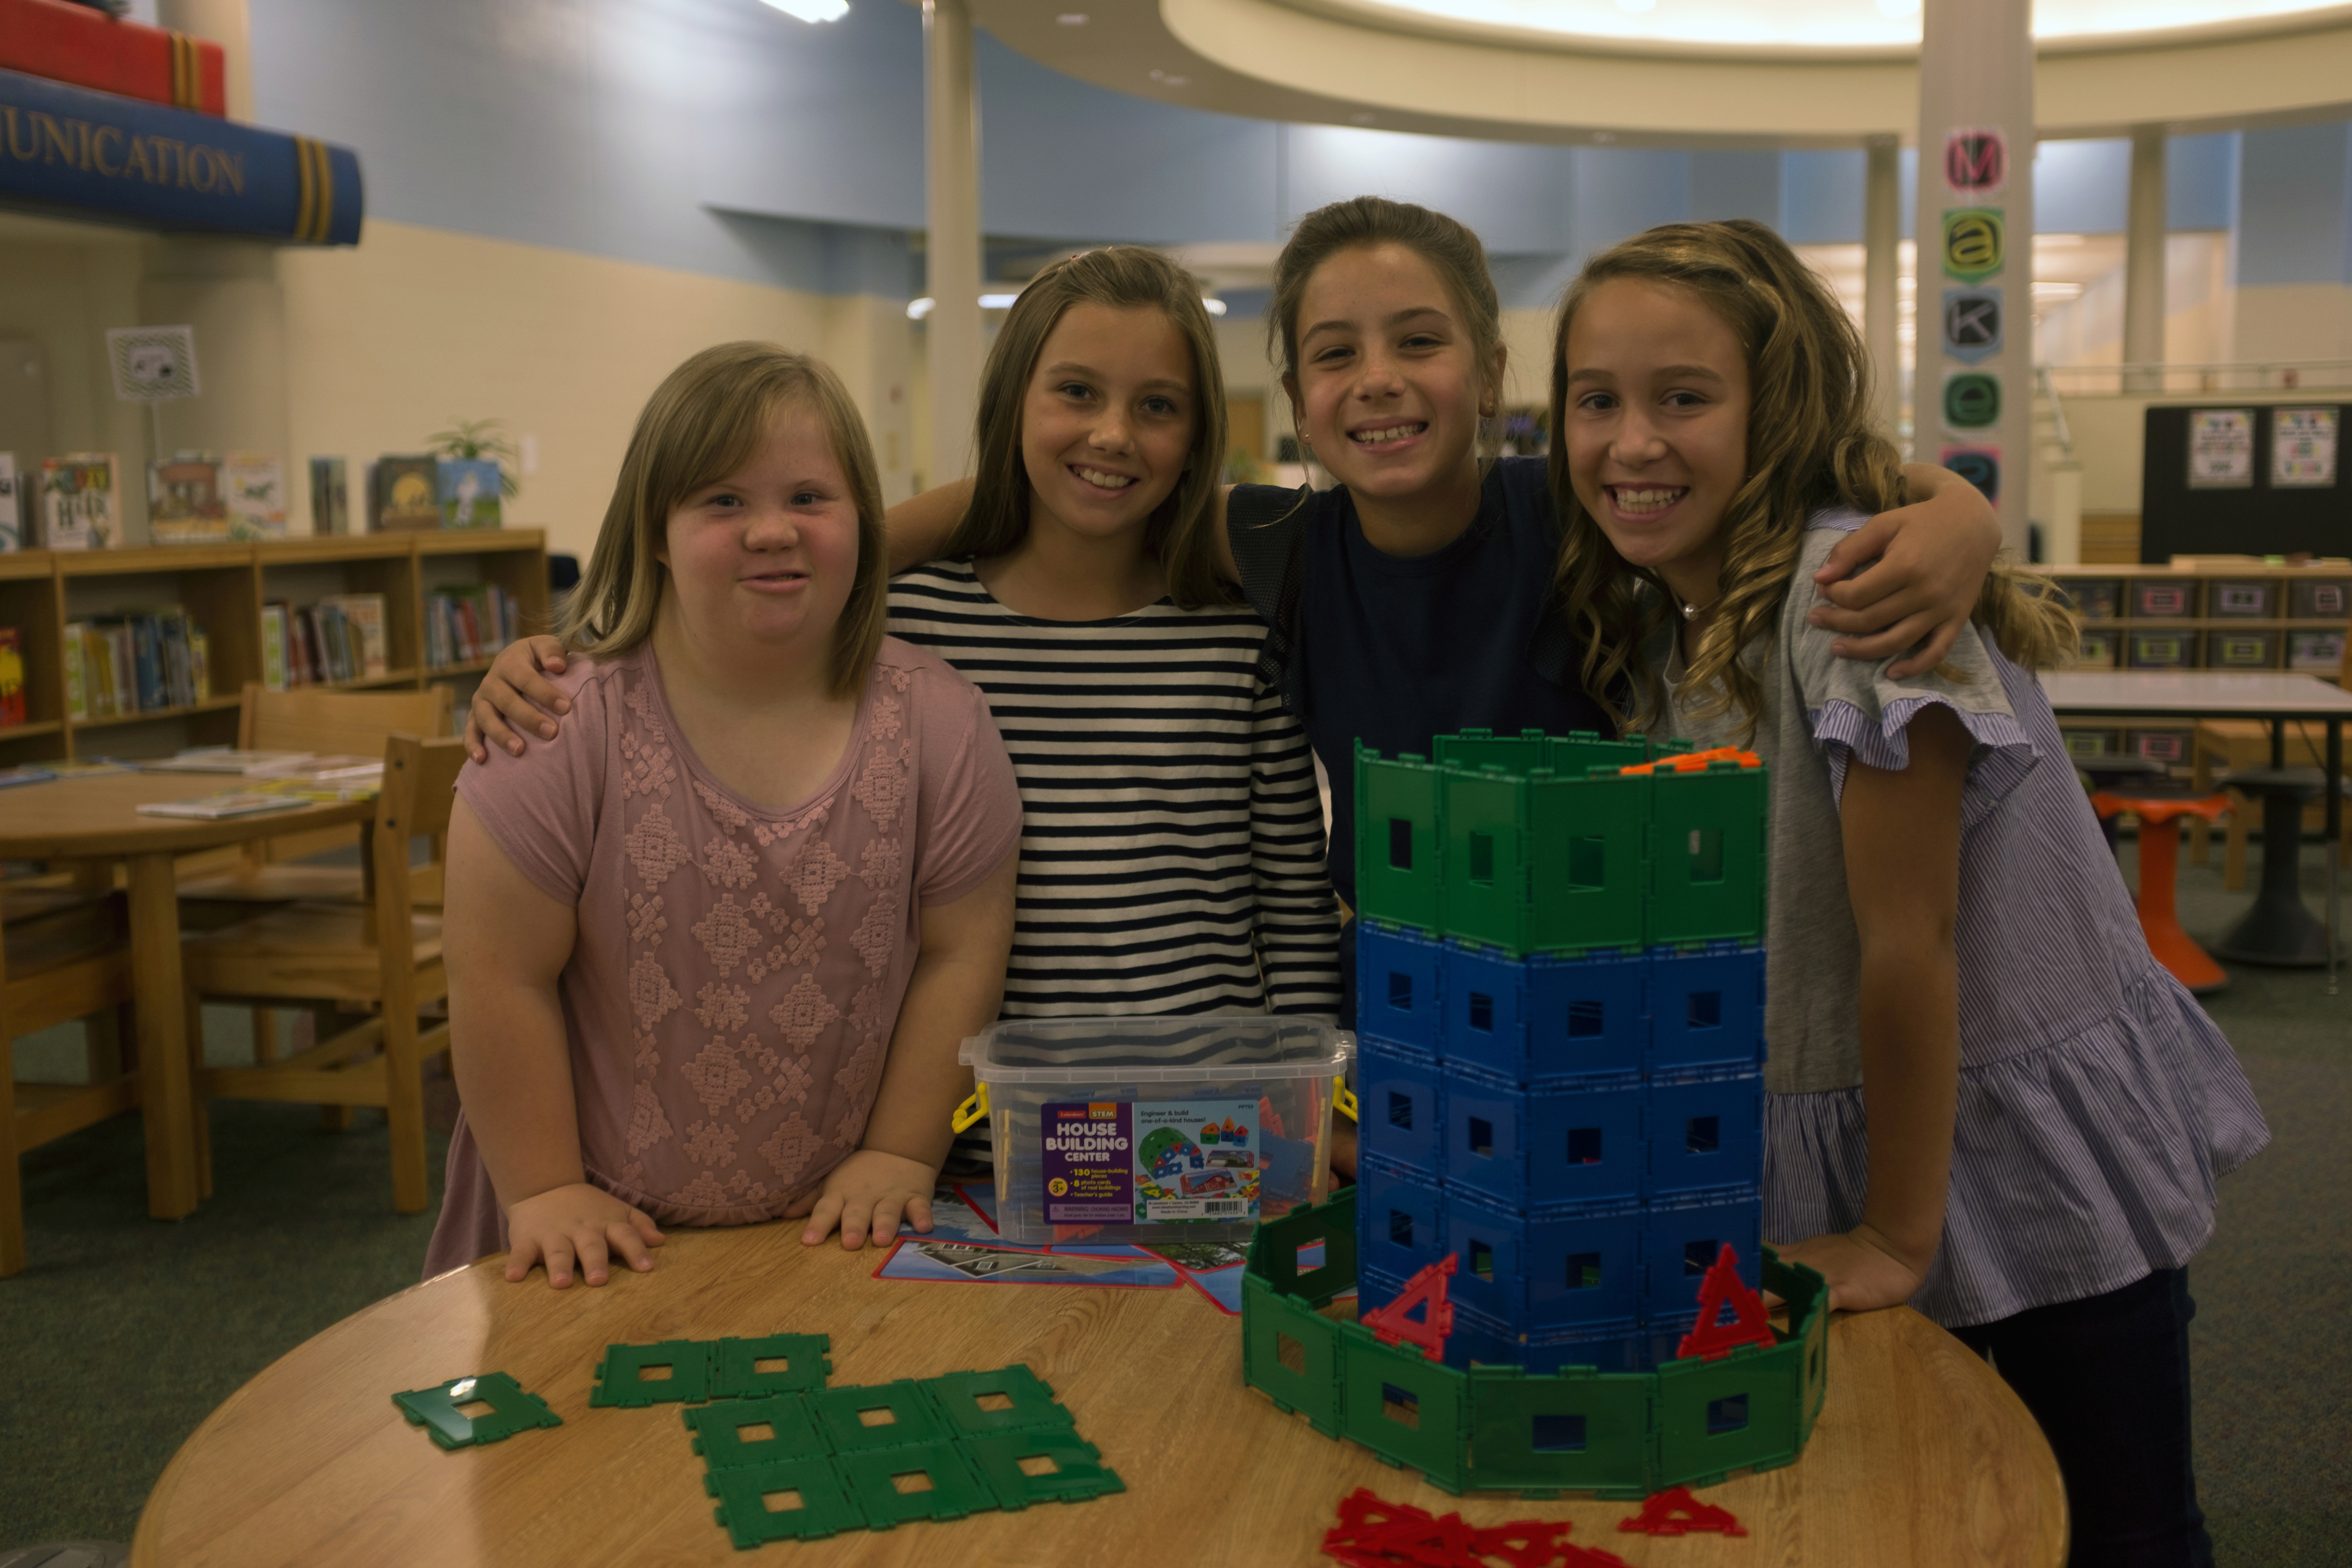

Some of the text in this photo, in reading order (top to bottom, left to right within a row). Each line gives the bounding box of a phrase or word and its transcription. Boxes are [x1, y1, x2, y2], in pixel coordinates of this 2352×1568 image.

[0, 104, 245, 196] UNICATION
[1057, 1122, 1117, 1136] HOUSE
[1046, 1137, 1128, 1151] BUILDING
[1065, 1152, 1110, 1162] CENTER
[1053, 1185, 1064, 1193] 3+
